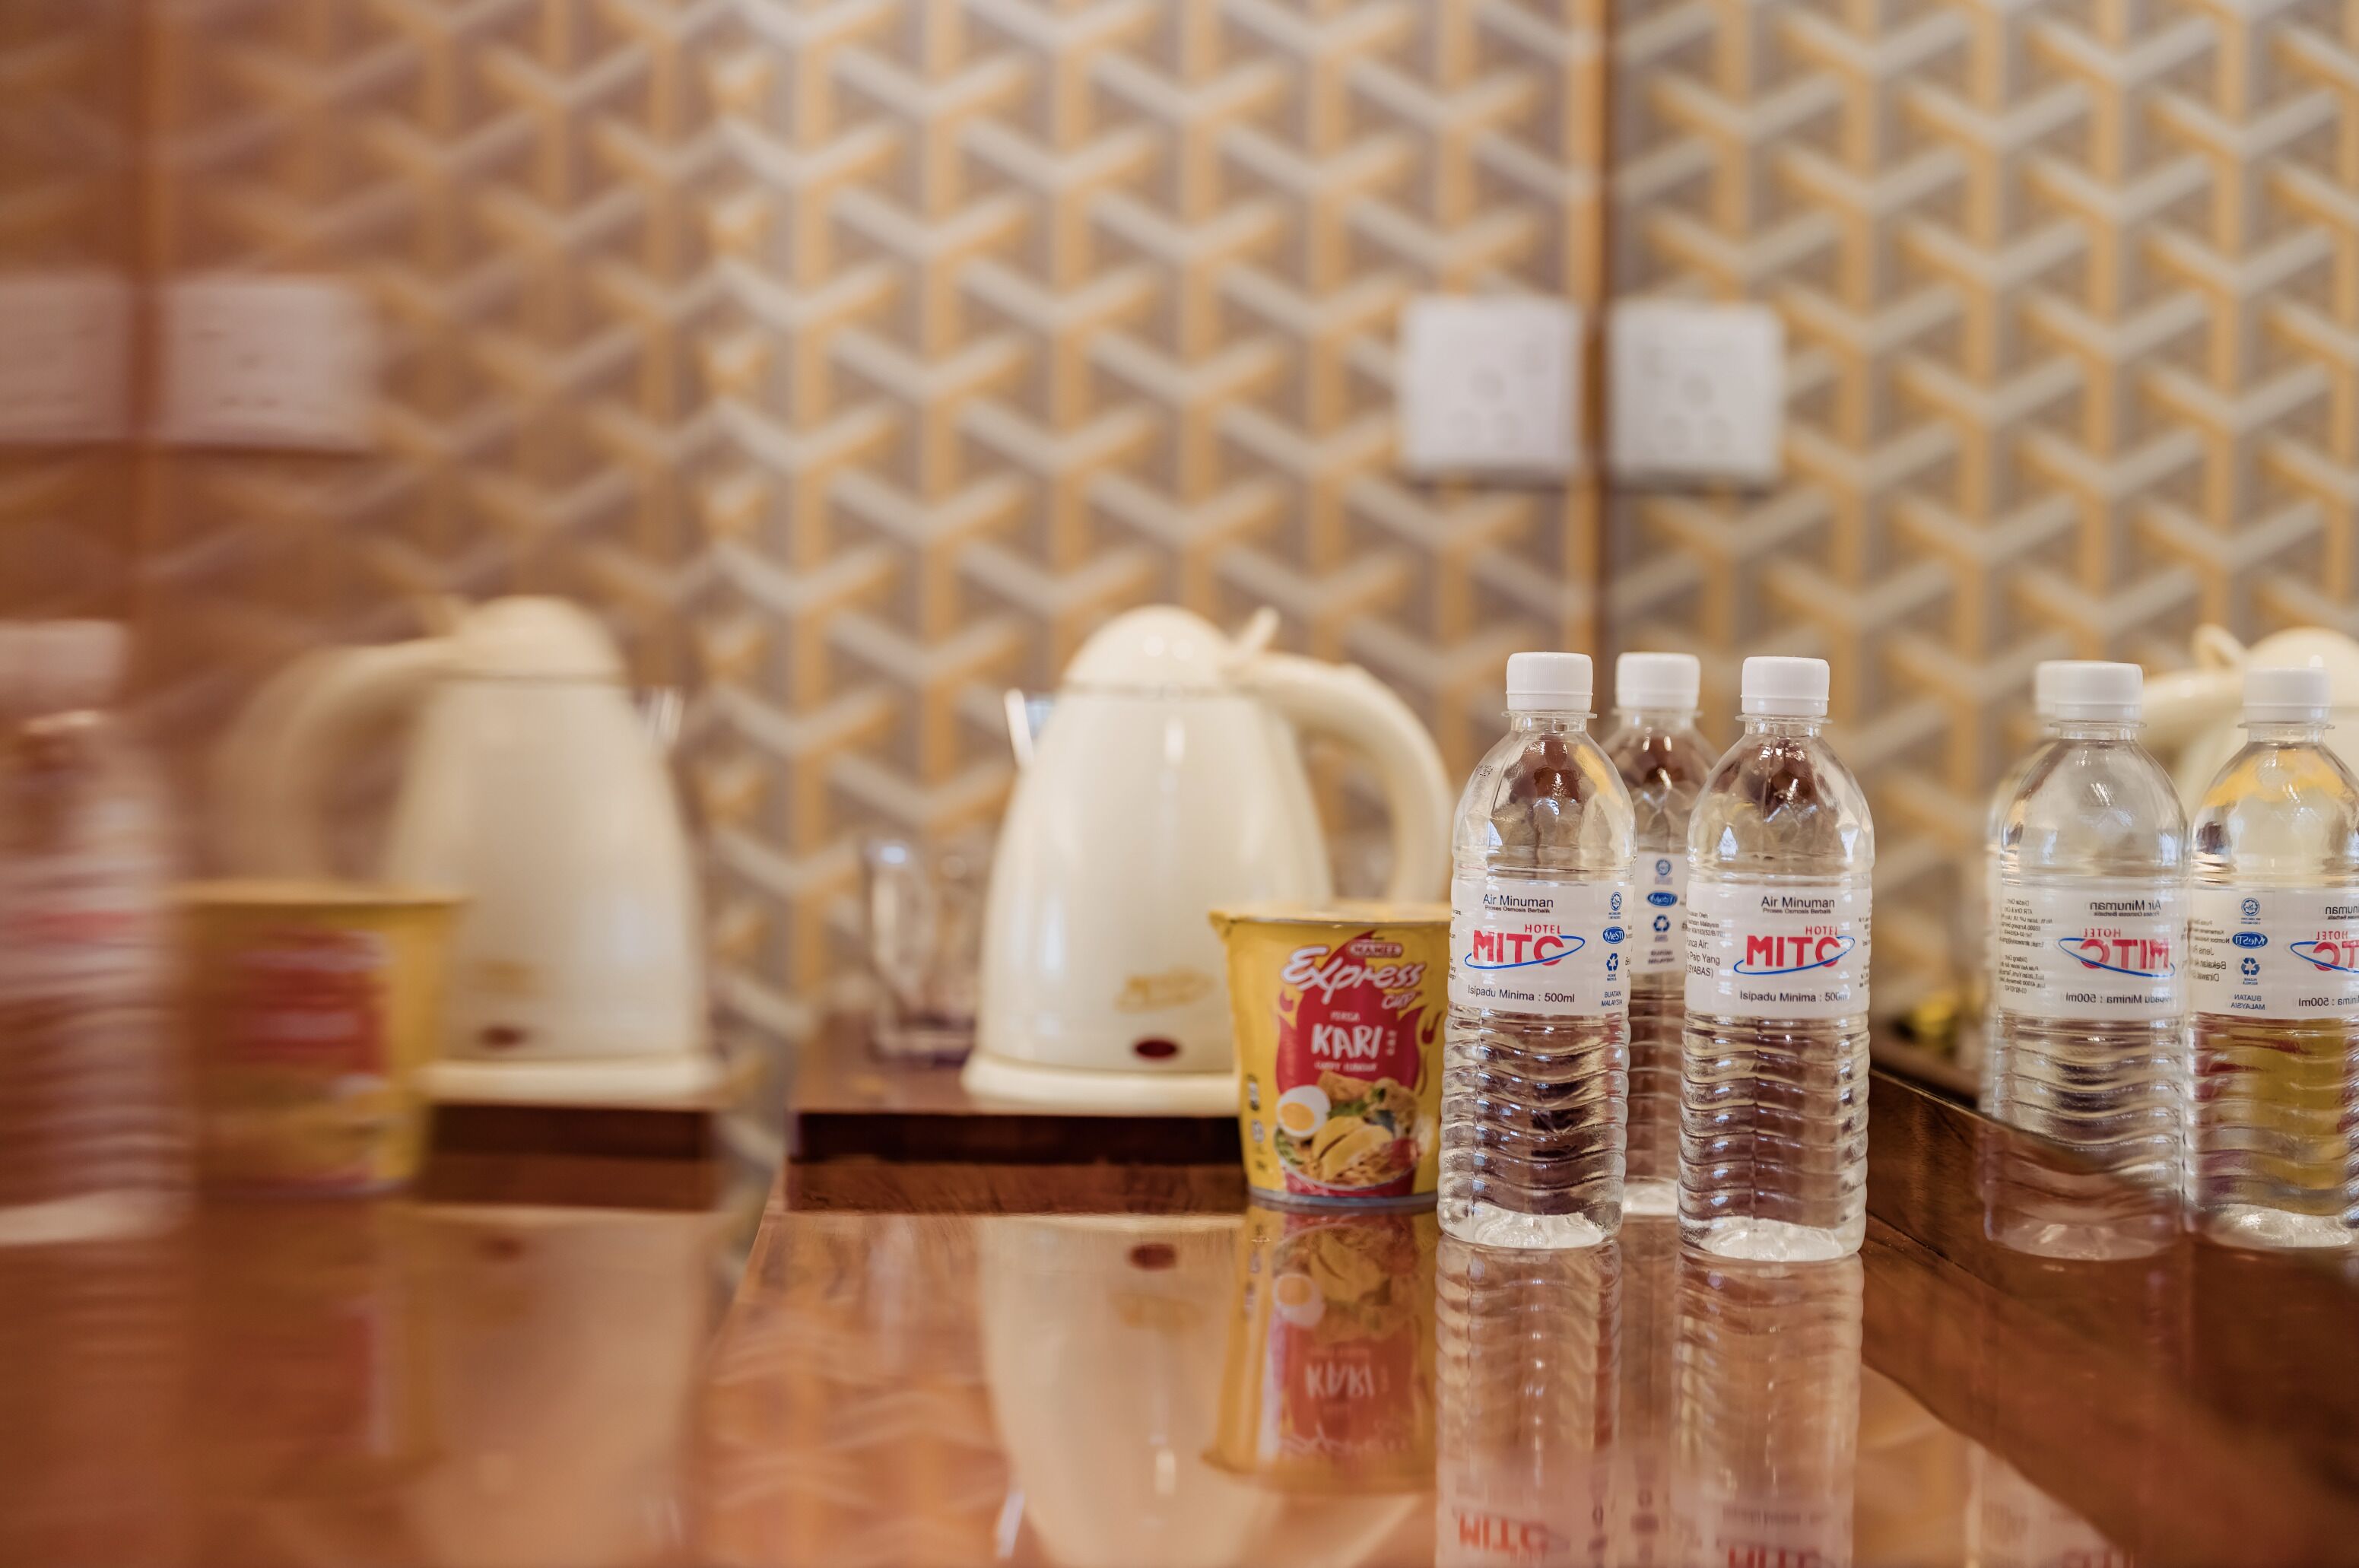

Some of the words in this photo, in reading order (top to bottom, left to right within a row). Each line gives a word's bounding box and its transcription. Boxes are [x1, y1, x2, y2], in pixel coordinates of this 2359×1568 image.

[1483, 894, 1497, 906] Air
[1500, 895, 1554, 908] Minuman
[1761, 896, 1778, 907] Air
[1782, 897, 1836, 908] Minuman
[1525, 924, 1561, 934] HOTEL
[1805, 925, 1838, 935] HOTEL
[1702, 954, 1720, 967] Yang
[1281, 945, 1427, 1005] Express
[1468, 985, 1496, 998] Isipadu
[1499, 989, 1535, 1001] Minima
[1544, 992, 1575, 1003] 500ml
[1740, 990, 1776, 1002] Isipadu
[1780, 992, 1816, 1002] Minima
[1601, 998, 1623, 1007] MALAYSIA
[1311, 1023, 1383, 1059] KARI
